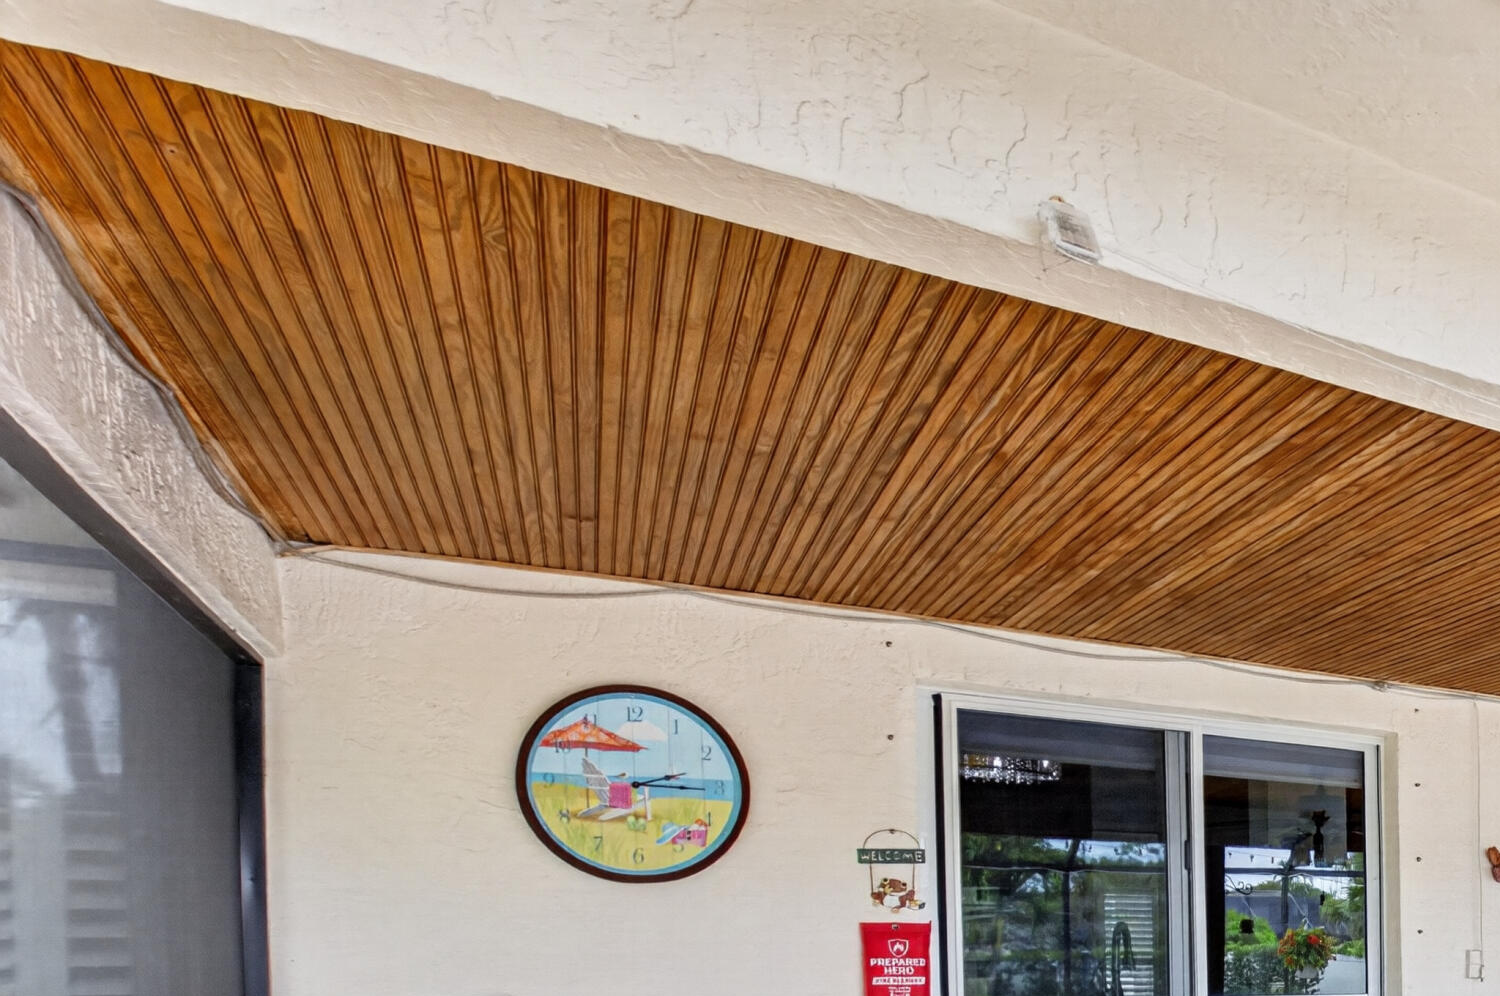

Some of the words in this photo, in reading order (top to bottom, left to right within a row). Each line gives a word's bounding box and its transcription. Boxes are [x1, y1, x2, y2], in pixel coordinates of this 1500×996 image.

[627, 706, 644, 722] 12
[674, 719, 678, 735] 1
[701, 745, 712, 761] 2
[543, 772, 555, 789] 9
[593, 835, 603, 852] 7
[632, 847, 644, 865] 6
[861, 850, 922, 862] WELCOME
[870, 957, 926, 967] PREPARED
[884, 966, 914, 975] HERO
